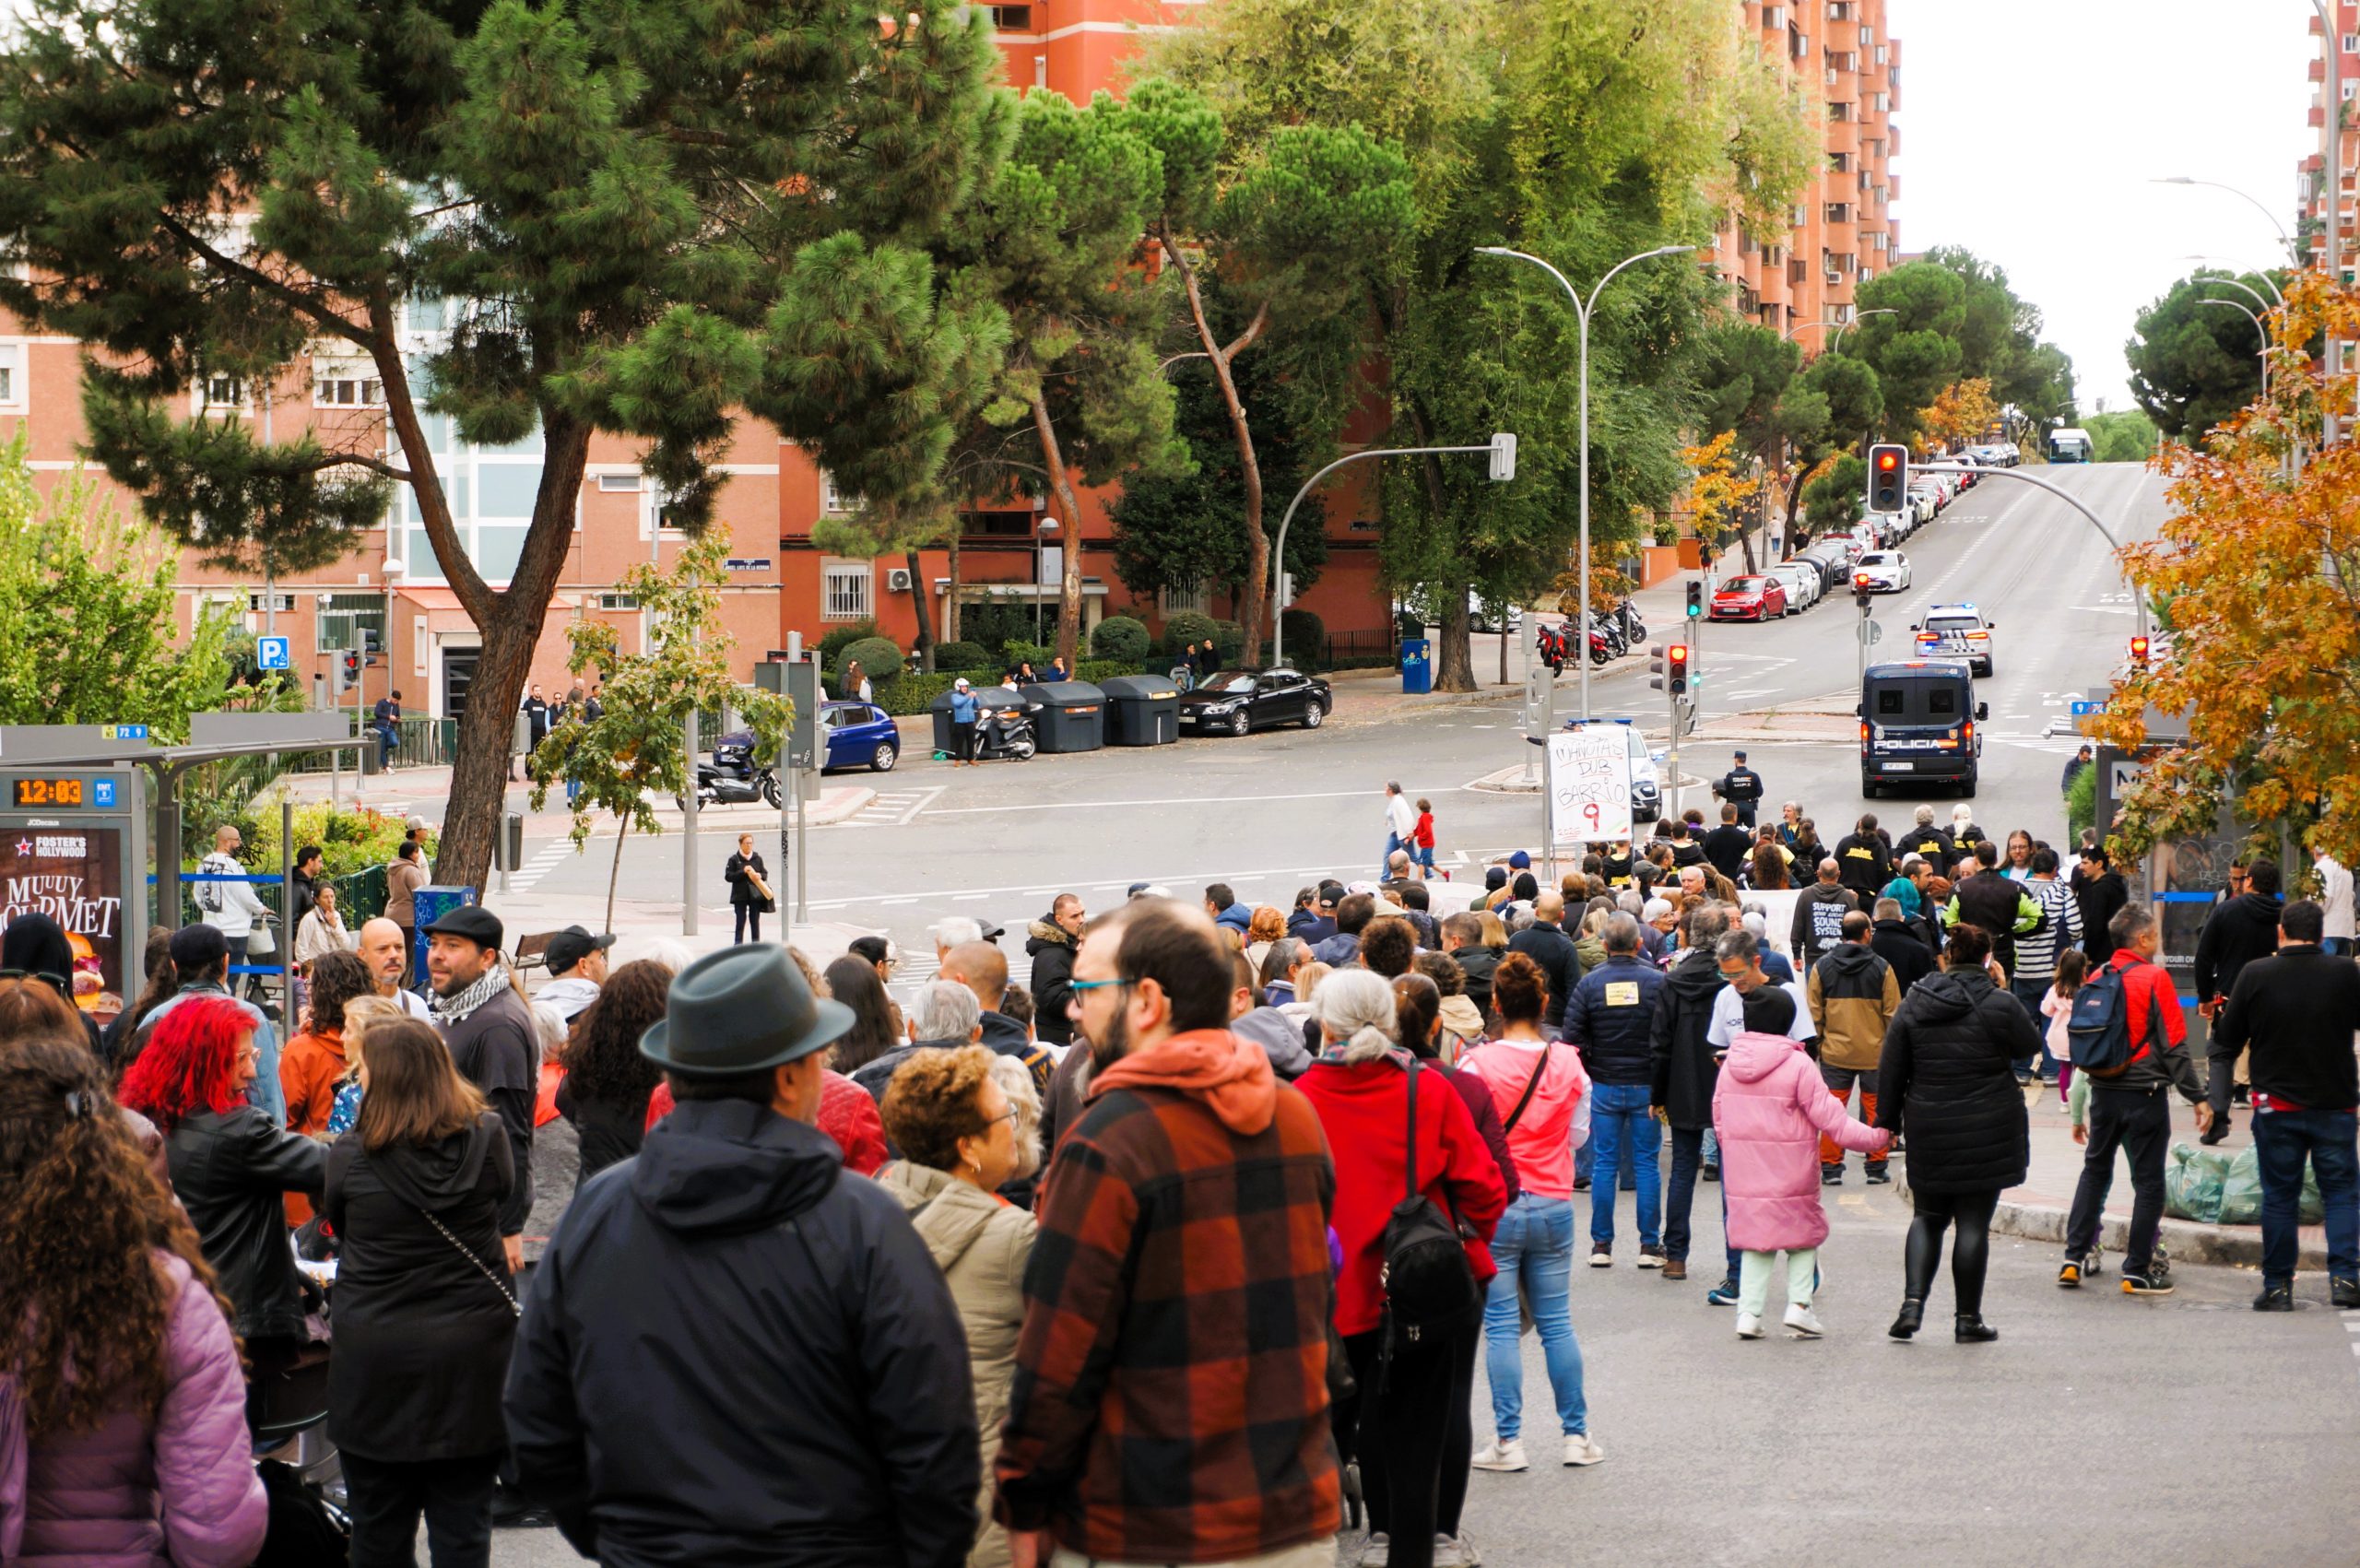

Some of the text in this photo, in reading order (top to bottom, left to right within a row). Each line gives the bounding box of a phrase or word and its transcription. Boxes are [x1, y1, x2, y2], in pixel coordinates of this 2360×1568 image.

[263, 640, 282, 666] P
[2077, 703, 2084, 713] 9
[119, 727, 130, 737] 72
[136, 727, 142, 737] 9
[1578, 759, 1612, 775] DUB
[19, 780, 82, 804] 12:03
[1558, 779, 1625, 806] BARRIO
[1583, 803, 1599, 832] 9
[35, 836, 87, 847] FOSTER'S
[36, 846, 87, 857] HOLLYWOOD
[7, 875, 85, 904] MUUUY
[1812, 902, 1847, 913] SUPPORT
